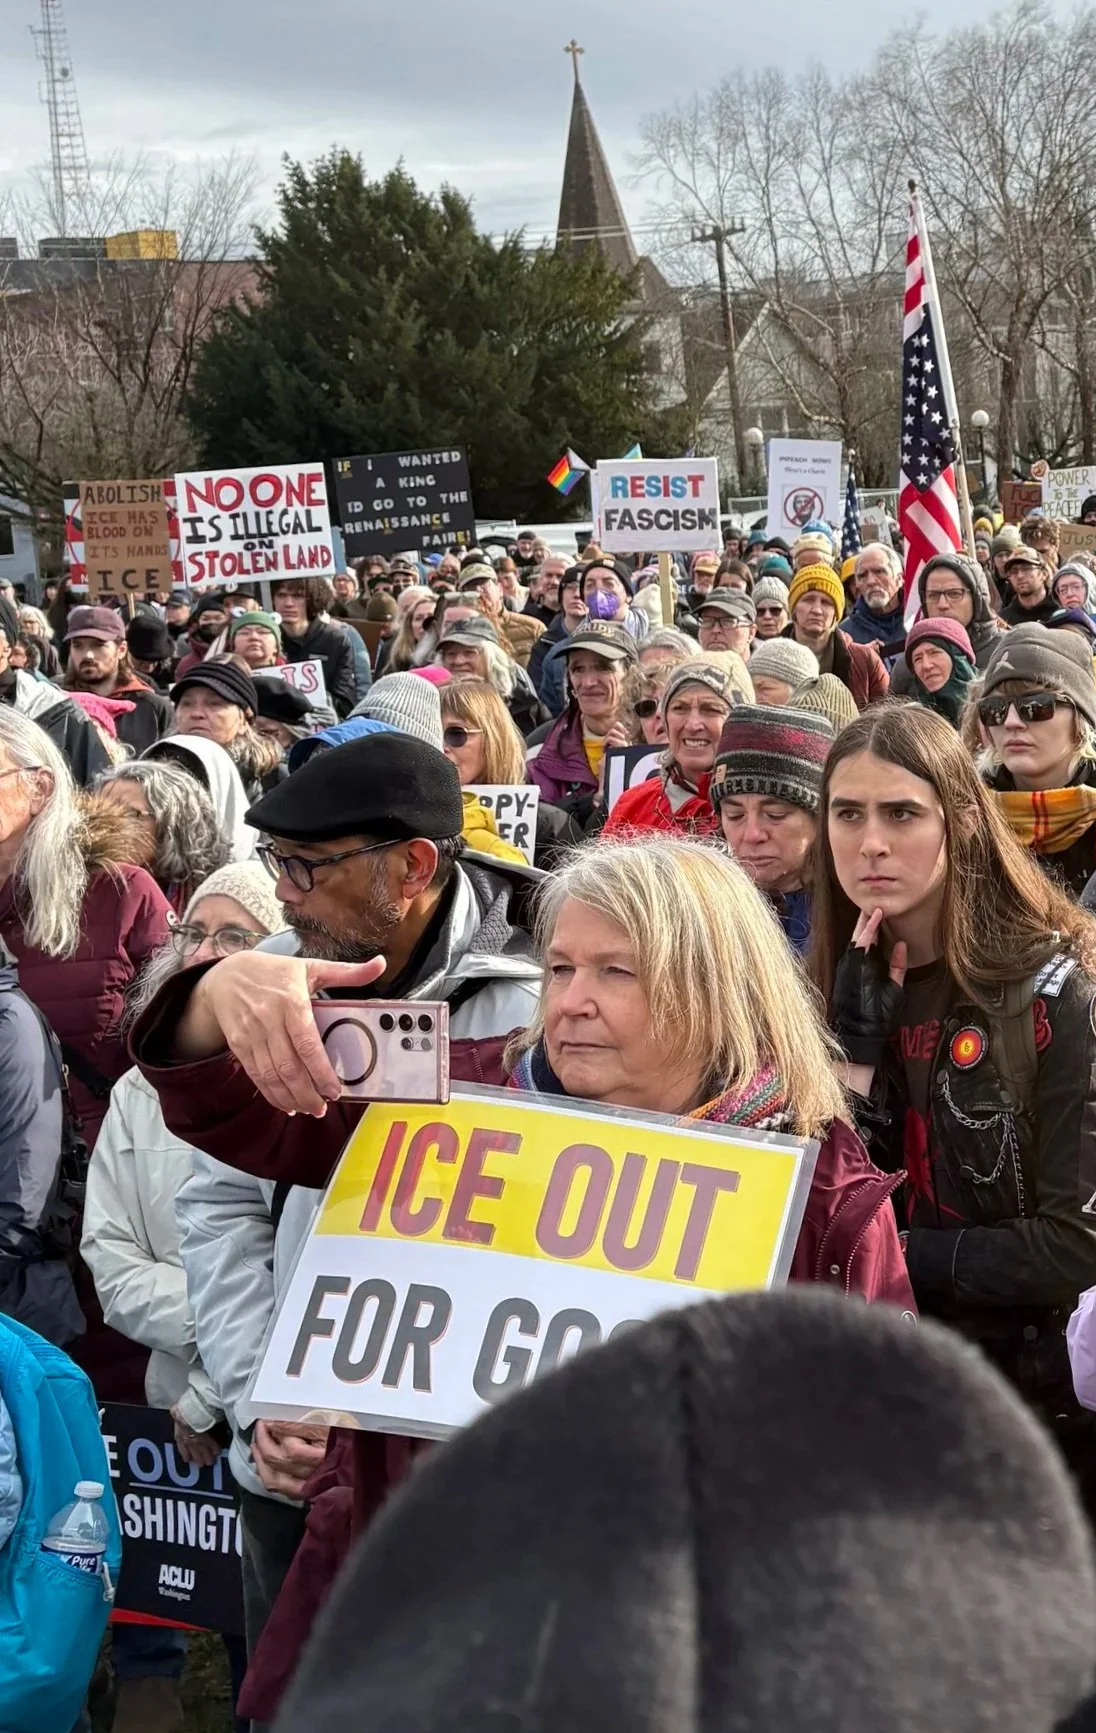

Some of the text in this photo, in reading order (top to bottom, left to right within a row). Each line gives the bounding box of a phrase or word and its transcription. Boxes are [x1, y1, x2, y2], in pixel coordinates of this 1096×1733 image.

[338, 461, 351, 472] IF
[398, 451, 461, 467] WANTED
[375, 475, 436, 488] A KING
[610, 474, 705, 499] RESIST
[1048, 469, 1090, 488] POWER
[84, 484, 161, 505] ABOLISH
[184, 473, 326, 513] NO ONE
[373, 499, 394, 511] GO
[407, 496, 427, 508] TO
[440, 491, 468, 504] THE
[87, 510, 159, 525] ICE HAS
[183, 509, 323, 544] IS ILLEGAL
[344, 512, 451, 534] RENAISSANCE
[604, 507, 717, 531] FASCISM
[87, 525, 153, 539] BLOOD ON
[422, 530, 471, 547] FAIRE!
[88, 544, 168, 558] ITS HANDS
[243, 539, 274, 551] ON
[188, 544, 332, 583] STOLEN LAND
[97, 569, 161, 591] ICE
[359, 1120, 740, 1282] ICE OUT
[285, 1274, 650, 1405] FOR GO
[127, 1438, 229, 1491] OUT
[114, 1493, 243, 1557] SHINGT
[72, 1555, 95, 1566] Pure
[158, 1564, 195, 1591] ACLU
